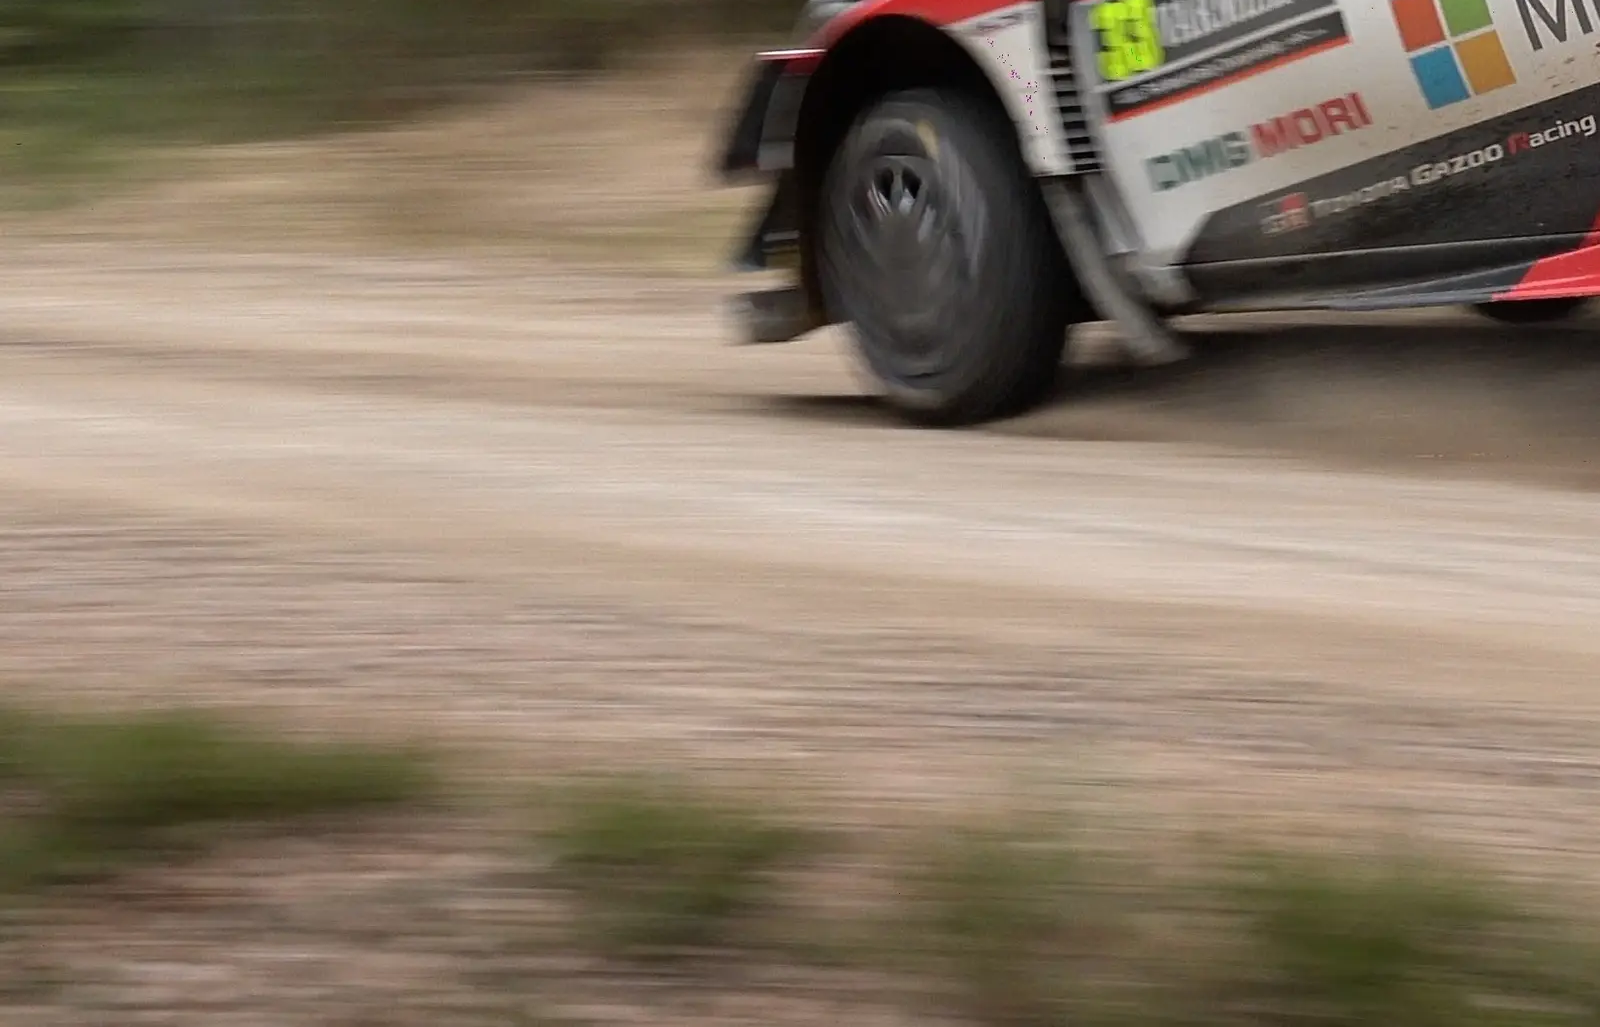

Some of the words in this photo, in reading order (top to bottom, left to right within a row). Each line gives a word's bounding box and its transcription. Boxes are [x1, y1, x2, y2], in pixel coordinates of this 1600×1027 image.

[1250, 92, 1373, 158] MORI
[1411, 144, 1505, 186] GAZOO
[1508, 114, 1597, 156] Racing
